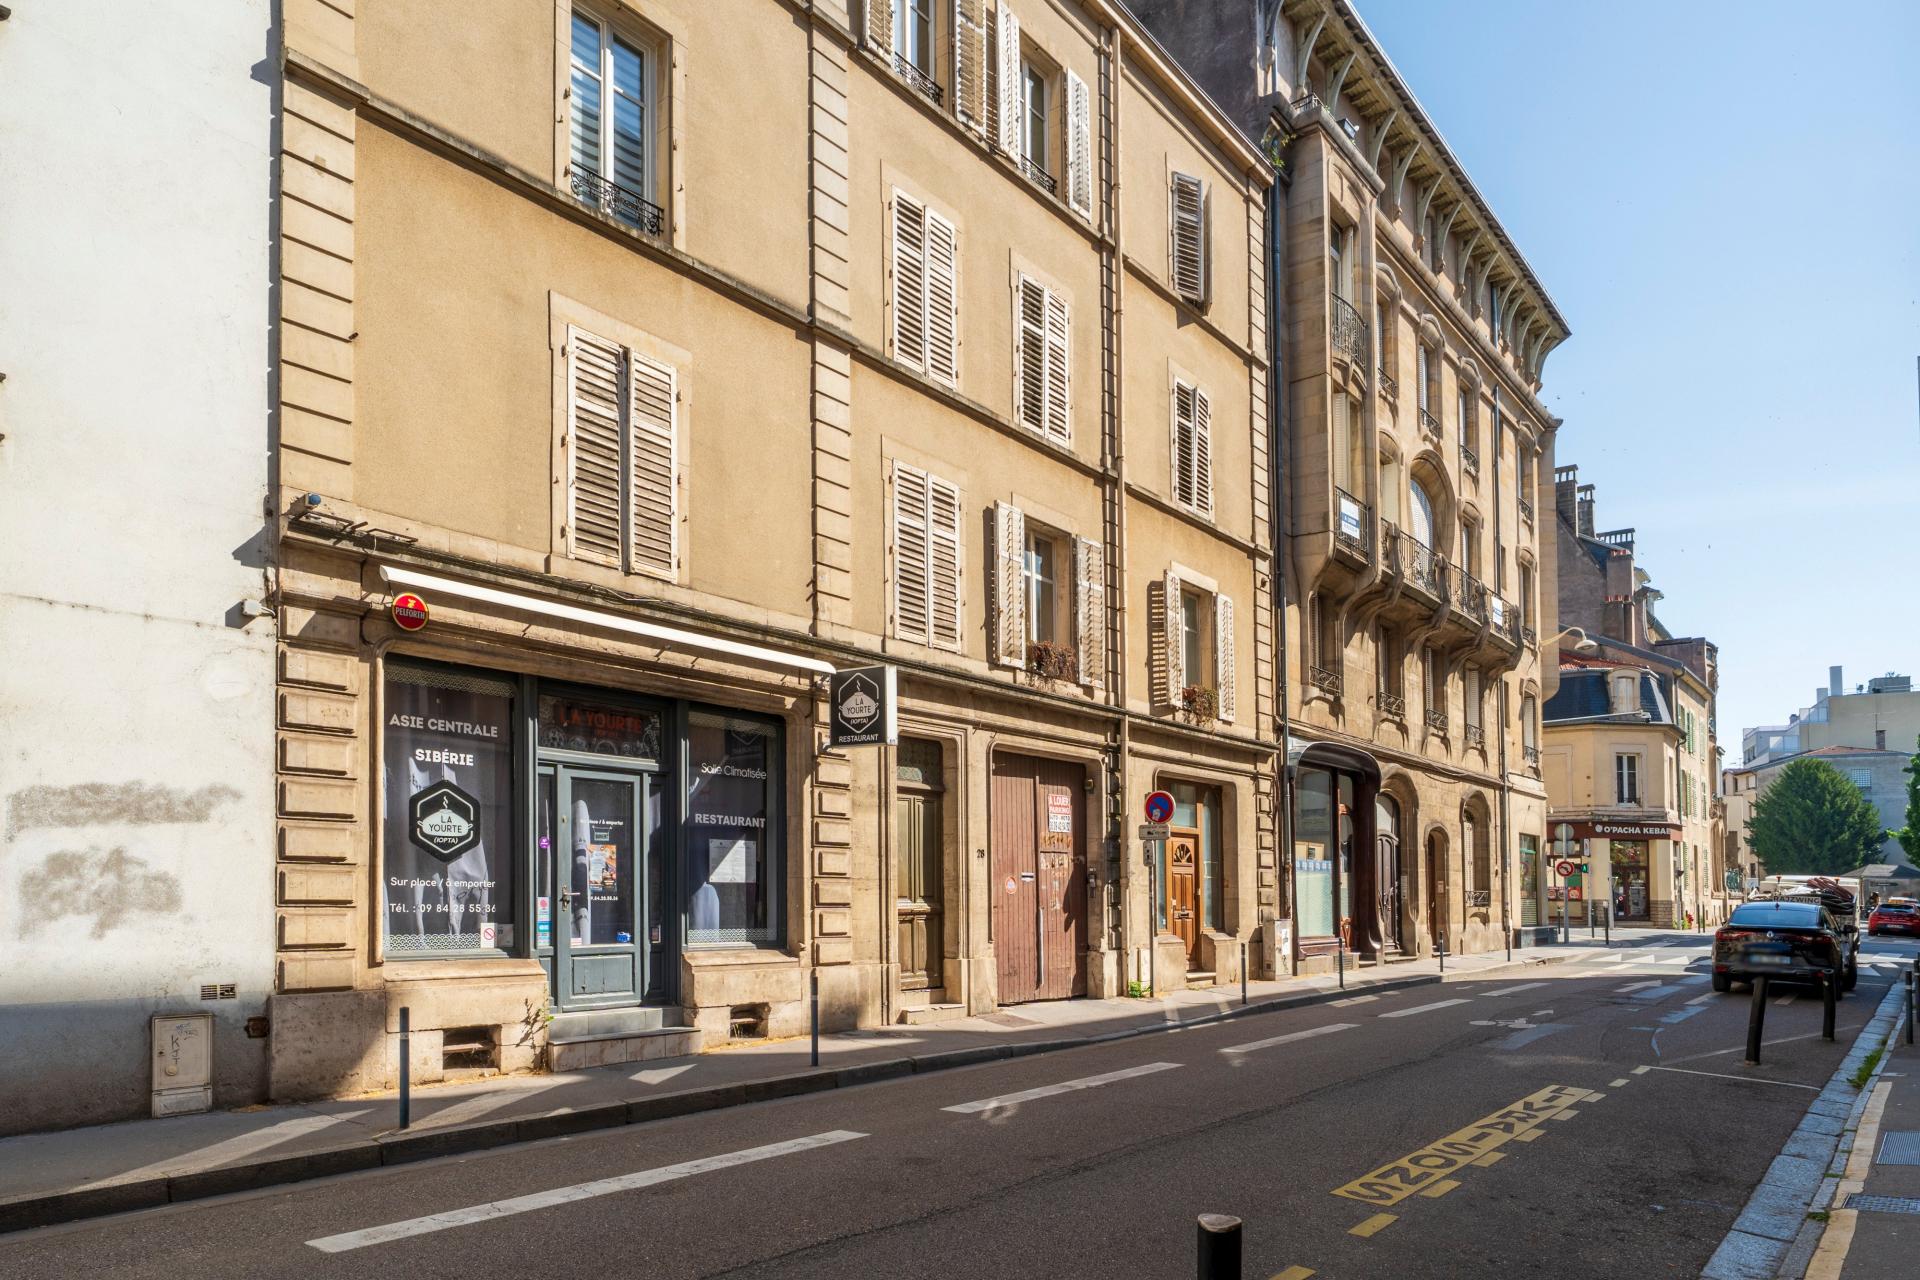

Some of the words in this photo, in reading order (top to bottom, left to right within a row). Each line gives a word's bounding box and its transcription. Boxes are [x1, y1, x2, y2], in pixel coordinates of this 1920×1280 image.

[395, 606, 425, 620] PELFORTH
[855, 697, 864, 706] LA
[847, 706, 872, 714] YOURTE
[389, 713, 424, 729] ASIE
[427, 718, 498, 738] CENTRALE
[838, 733, 879, 743] RESTAURANT
[415, 748, 474, 766] SIBÉRIE
[701, 762, 722, 775] Salle
[723, 765, 767, 780] Climatisée
[440, 814, 453, 824] LA
[695, 813, 766, 828] RESTAURANT
[428, 824, 462, 834] YOURTE
[1604, 826, 1641, 834] O'PACHA
[390, 876, 408, 886] Sur
[410, 877, 437, 888] place
[454, 879, 496, 889] emporter
[419, 903, 432, 913] 09
[436, 903, 449, 913] 84
[453, 903, 465, 913] 28
[469, 903, 481, 913] 55
[1344, 1086, 1576, 1200] LIVRAISONS
